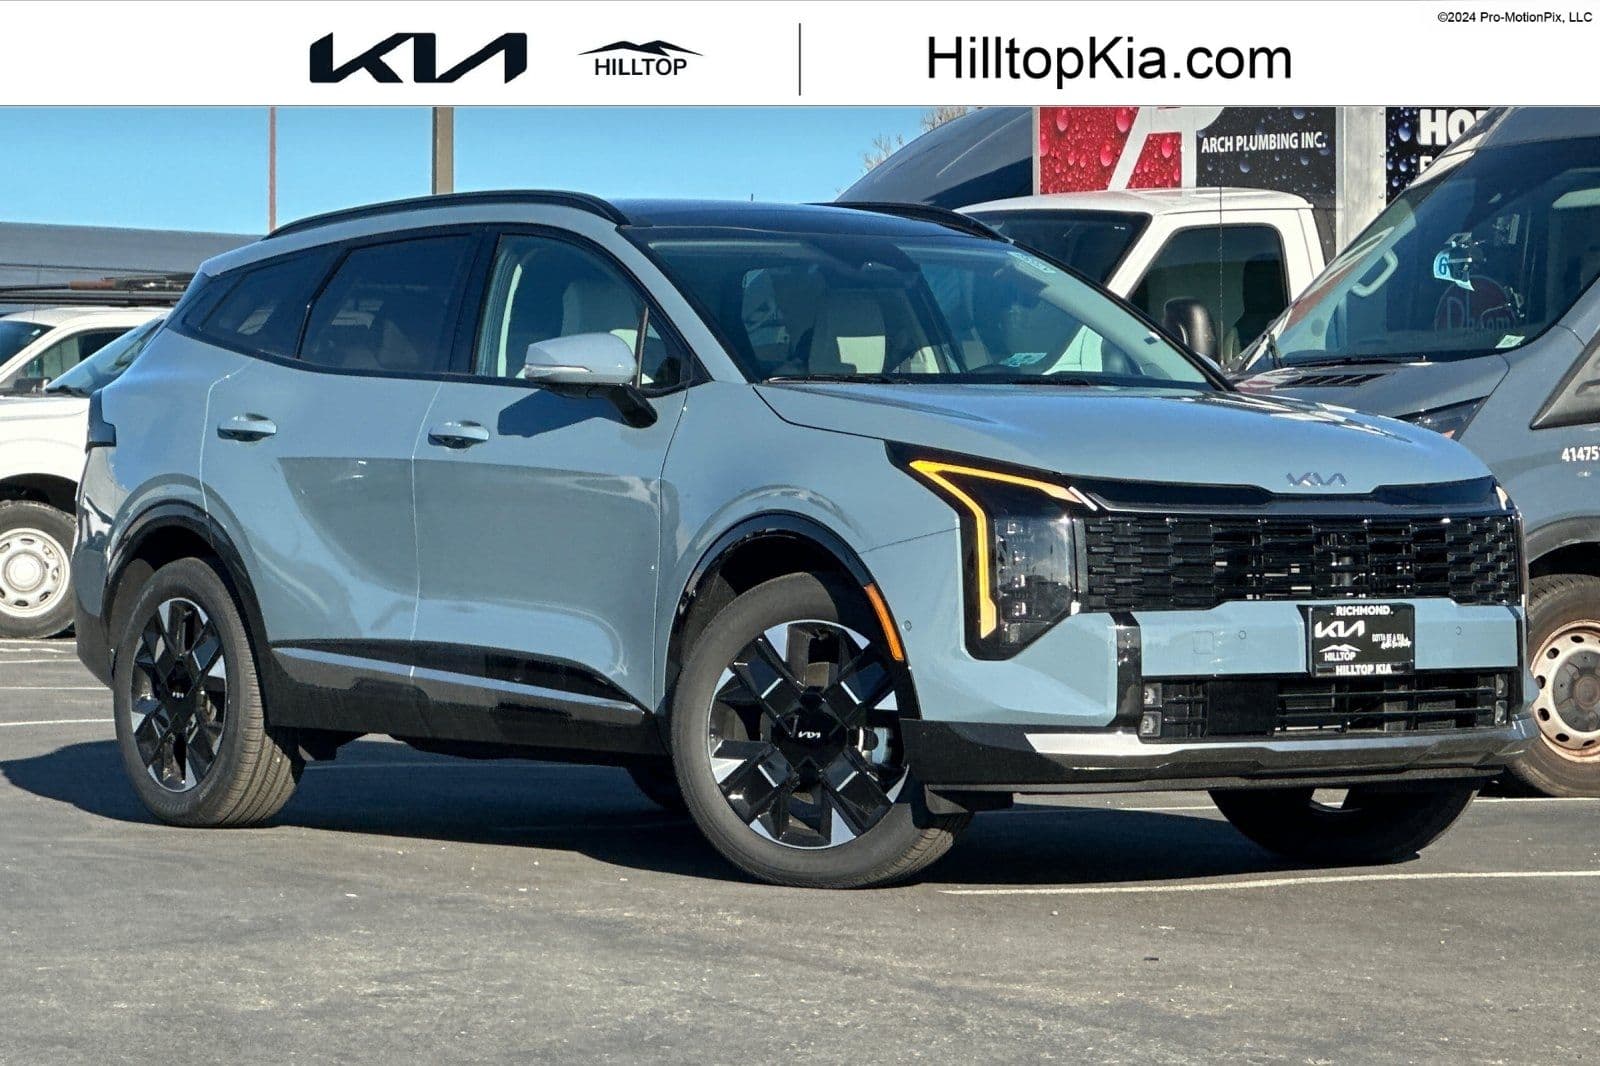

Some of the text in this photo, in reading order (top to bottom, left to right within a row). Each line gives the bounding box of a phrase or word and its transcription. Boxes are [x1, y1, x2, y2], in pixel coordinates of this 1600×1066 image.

[1419, 108, 1488, 146] HO
[1201, 131, 1327, 153] ARCH PLUMBING INC.
[1561, 445, 1600, 462] 41475
[1335, 605, 1391, 616] RICHMOND
[1314, 620, 1365, 638] KIA
[1324, 651, 1357, 662] HILLTOP
[1335, 663, 1393, 675] HILLTOP KIA
